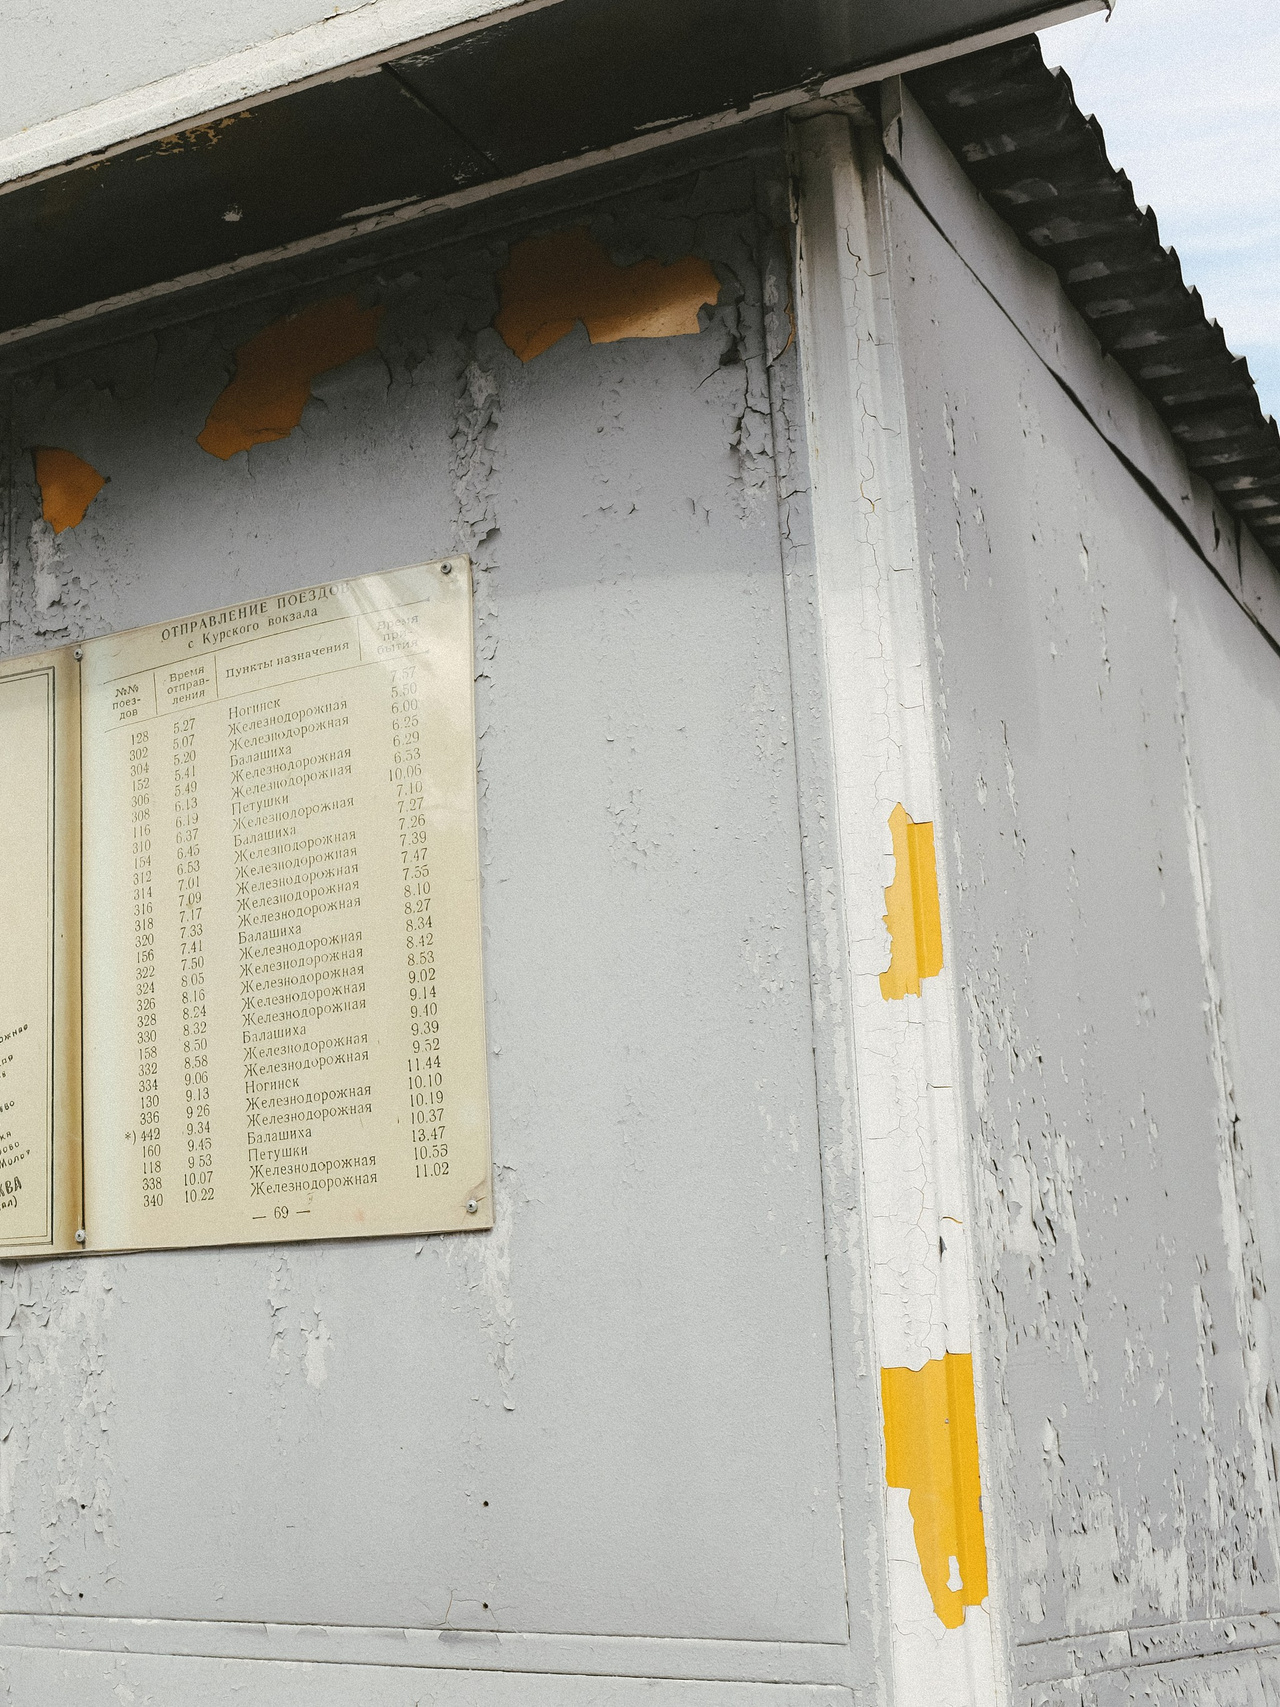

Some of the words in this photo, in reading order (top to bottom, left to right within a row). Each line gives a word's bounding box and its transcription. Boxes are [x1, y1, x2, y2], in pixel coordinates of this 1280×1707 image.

[161, 601, 269, 642] ОТПРАВЛЕНИЕ
[277, 582, 351, 610] ПОЕЗДОВ
[188, 640, 195, 649] с
[202, 622, 260, 645] Курского
[268, 607, 318, 627] вокзала
[376, 614, 419, 631] Время
[170, 666, 206, 684] Время
[225, 659, 273, 679] Пункты
[276, 641, 350, 666] назначения
[377, 639, 419, 655] бытия
[112, 698, 141, 710] поез-
[119, 708, 139, 721] дов
[167, 678, 210, 696] отправ-
[172, 690, 206, 705] ления
[129, 746, 149, 762] 302
[172, 733, 195, 750] 5.07
[227, 700, 348, 737] Железнодорожная
[132, 777, 150, 792] 152
[174, 764, 196, 782] 5.41
[229, 745, 292, 768] Балашиха
[391, 714, 420, 731] 6.25
[133, 823, 152, 839] 116
[175, 812, 199, 828] 6.19
[231, 794, 289, 816] Петушки
[389, 765, 422, 782] 10.06
[132, 870, 152, 886] 312
[176, 859, 201, 876] 6.53
[234, 830, 356, 864] Железнодорожная
[398, 813, 427, 831] 7.26
[133, 886, 153, 901] 314
[177, 875, 200, 892] 7.01
[235, 847, 357, 880] Железнодорожная
[399, 830, 427, 847] 7.39
[134, 917, 154, 932] 318
[179, 906, 203, 923] 7.17
[236, 880, 359, 913] Железнодорожная
[402, 863, 430, 881] 7.55
[134, 933, 155, 948] 320
[179, 923, 204, 939] 7.33
[238, 897, 361, 929] Железнодорожная
[403, 881, 431, 898] 8.10
[135, 965, 156, 980] 322
[180, 955, 205, 972] 7.50
[239, 931, 363, 961] Железнодорожная
[405, 915, 433, 932] 8.34
[137, 948, 155, 964] 156
[180, 939, 202, 955] 7.41
[238, 925, 302, 945] Балашиха
[404, 897, 432, 915] 8.27
[136, 997, 156, 1012] 326
[181, 988, 206, 1005] 8.16
[240, 965, 365, 995] Железнодорожная
[407, 950, 435, 967] 8.53
[136, 1012, 157, 1028] 328
[182, 1004, 207, 1021] 8.24
[241, 982, 366, 1013] Железнодорожная
[408, 967, 436, 985] 9.02
[137, 1029, 157, 1045] 330
[182, 1020, 208, 1037] 8.32
[242, 999, 367, 1027] Железнодорожная
[409, 985, 437, 1002] 9.14
[139, 1045, 158, 1061] 158
[183, 1038, 208, 1053] 8.50
[242, 1025, 307, 1044] Балашиха
[410, 1002, 438, 1019] 9.40
[138, 1062, 158, 1077] 332
[184, 1054, 209, 1070] 8.58
[243, 1033, 368, 1062] Железнодорожная
[410, 1020, 440, 1037] 9.39
[140, 1094, 160, 1110] 130
[185, 1086, 210, 1103] 9.13
[245, 1077, 300, 1094] Ногинск
[407, 1055, 441, 1073] 11.44
[142, 1143, 162, 1159] 160
[247, 1128, 312, 1145] Балашиха
[411, 1107, 445, 1125] 10.37
[186, 1120, 211, 1136] 9.34
[246, 1103, 372, 1127] Железнодорожная
[410, 1089, 444, 1108] 10.19
[143, 1193, 164, 1208] 340
[184, 1187, 215, 1204] 10.22
[250, 1173, 378, 1197] Железнодорожная
[415, 1161, 450, 1179] 11.02
[273, 1205, 289, 1220] 69
